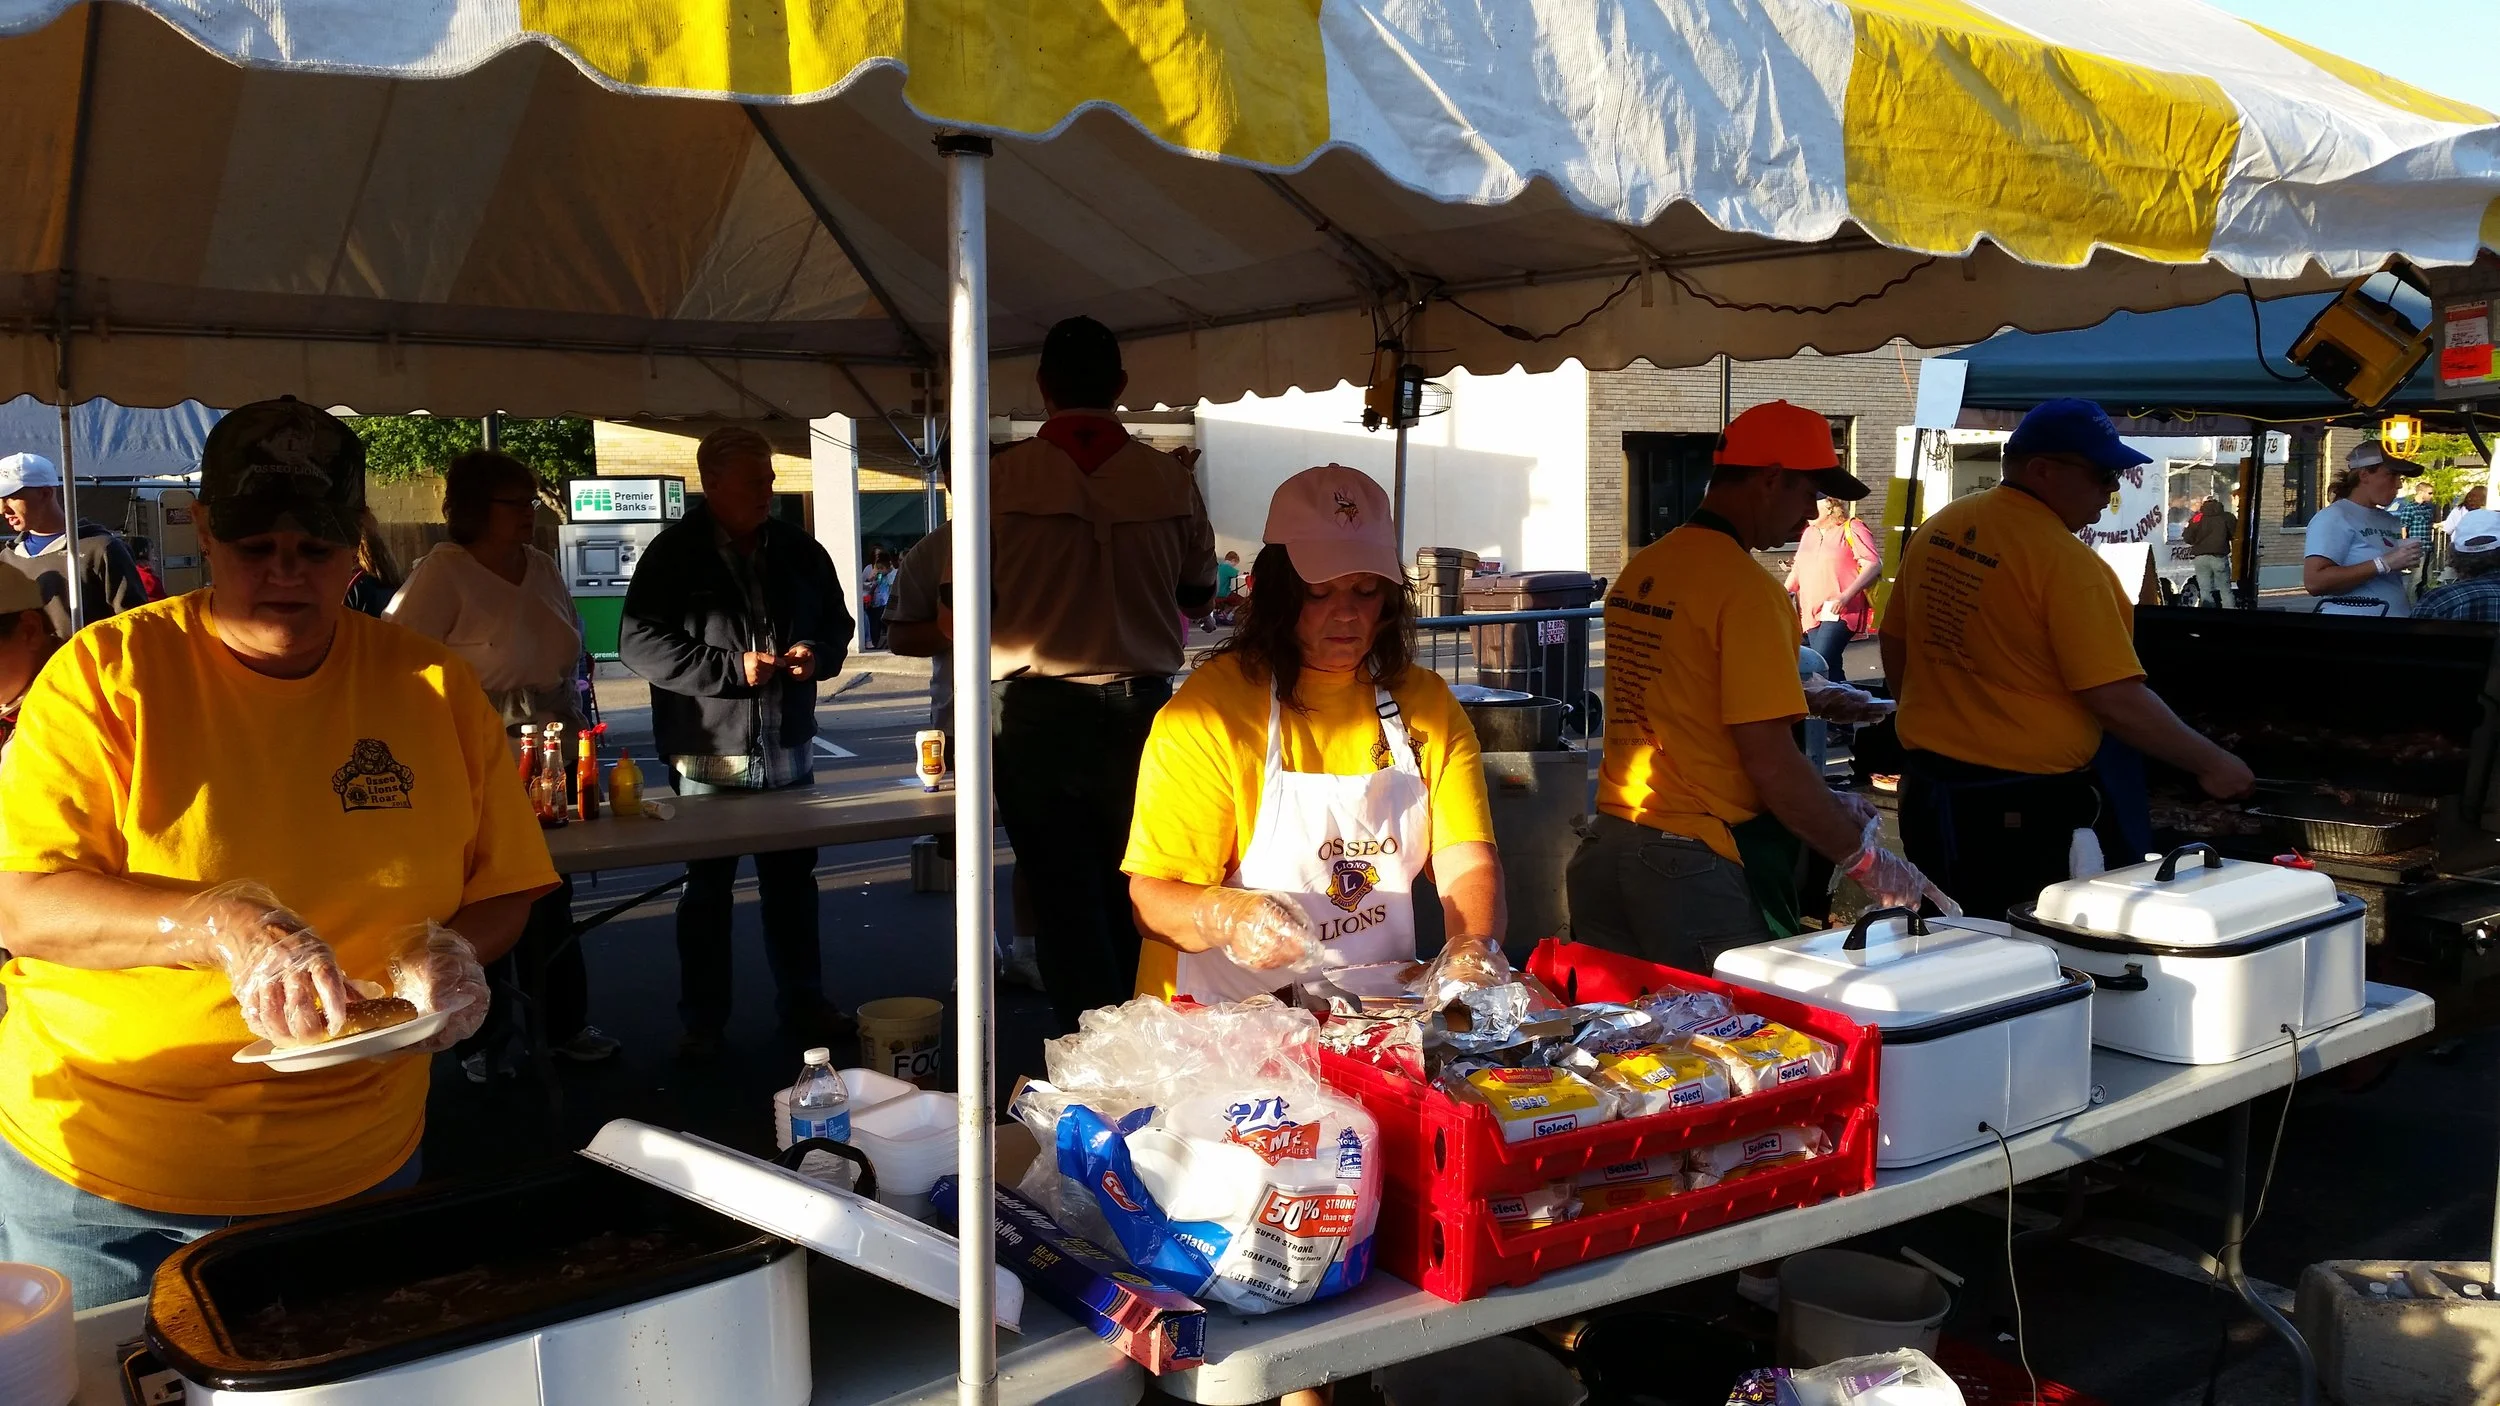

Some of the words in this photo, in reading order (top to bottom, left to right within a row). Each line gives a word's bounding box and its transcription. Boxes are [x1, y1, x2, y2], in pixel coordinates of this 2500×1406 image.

[614, 491, 654, 501] Premier
[615, 502, 647, 512] Banks
[367, 785, 399, 795] Lions
[370, 795, 398, 804] Roar
[1318, 837, 1398, 861] OSSEO
[1335, 861, 1368, 873] LIONS
[1341, 873, 1357, 894] L
[1319, 904, 1386, 942] LIONS
[1781, 1064, 1808, 1080] Select
[1673, 1088, 1701, 1104] Select
[1537, 1120, 1574, 1137] Select
[1748, 1139, 1777, 1155] Select
[1607, 1161, 1643, 1174] Select
[1265, 1195, 1320, 1232] 50%
[1323, 1213, 1337, 1221] than
[1001, 1222, 1024, 1247] Wrap
[1319, 1225, 1336, 1234] foam
[1179, 1233, 1217, 1257] Platos
[1254, 1227, 1282, 1243] SUPER
[1281, 1239, 1314, 1254] STRONG
[1032, 1244, 1062, 1265] HEAVY
[1241, 1249, 1265, 1263] SOAK
[1265, 1257, 1293, 1273] PROOF
[1027, 1255, 1049, 1271] DUTY
[1246, 1277, 1293, 1300] RESISTANT
